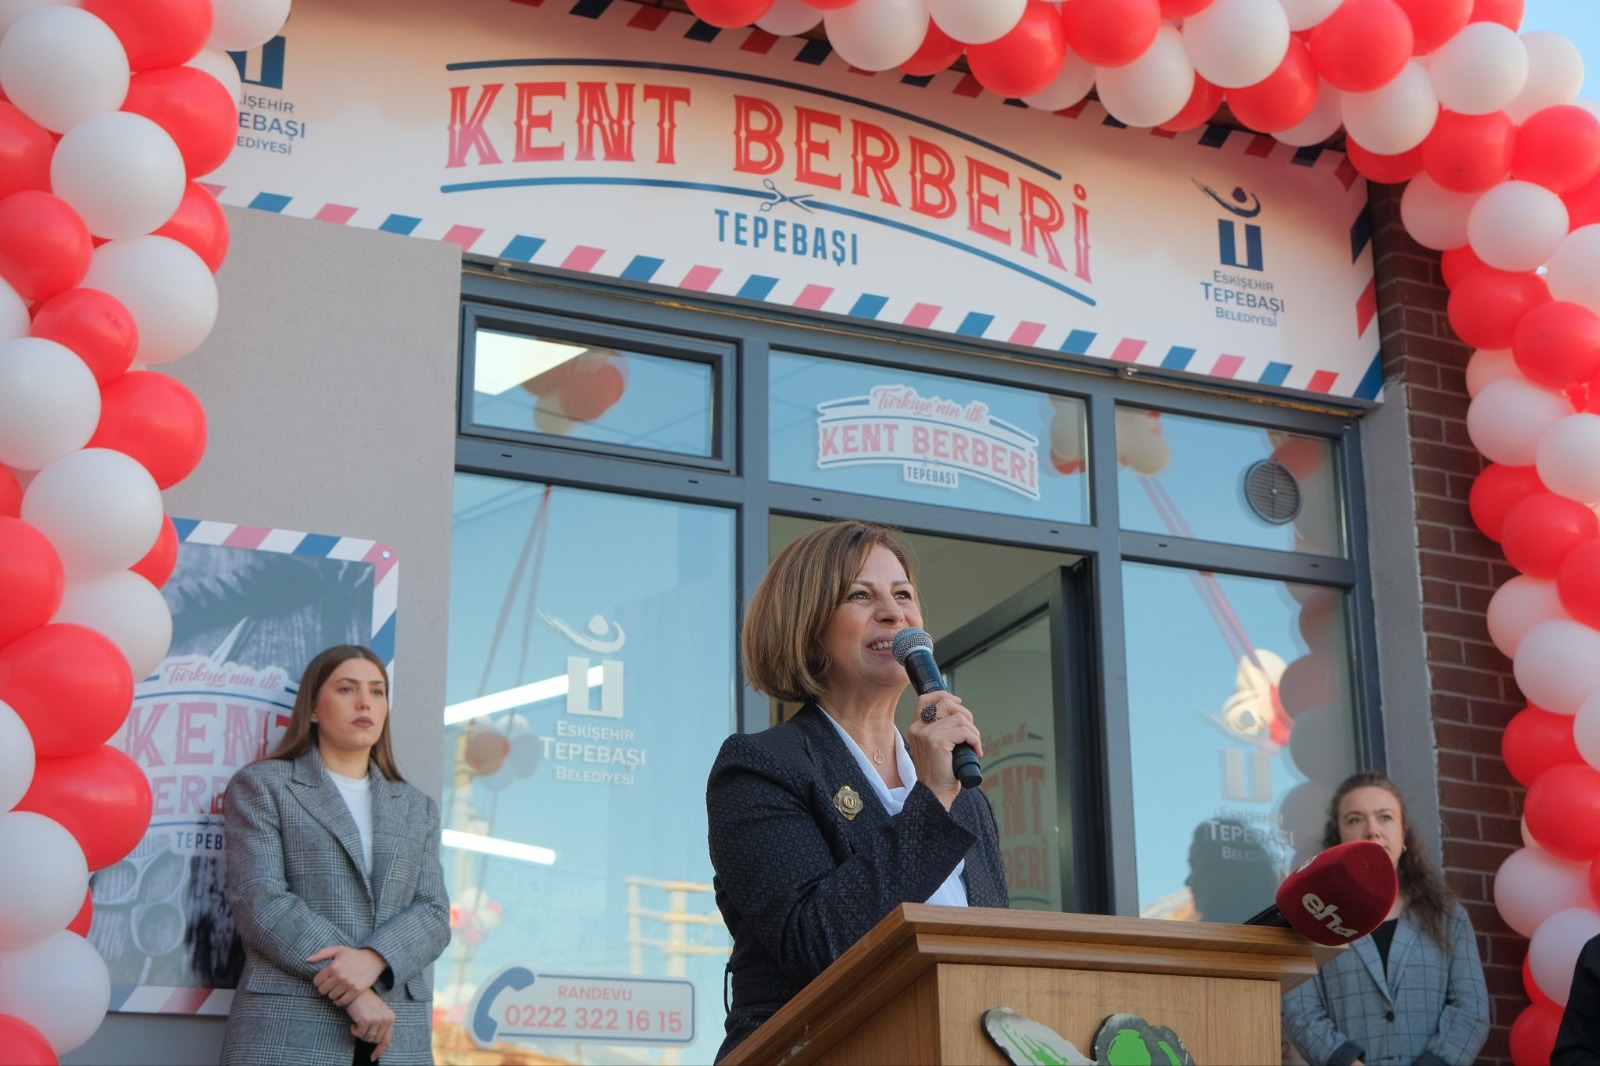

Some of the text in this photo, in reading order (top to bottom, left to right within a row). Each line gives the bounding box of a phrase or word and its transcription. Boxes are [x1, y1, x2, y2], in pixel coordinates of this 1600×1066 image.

[240, 92, 294, 114] İŞEHİR
[239, 111, 305, 141] EBAŞI
[237, 136, 292, 155] EDİYESİ
[444, 81, 1092, 284] KENT BERBERİ
[714, 209, 858, 266] TEPEBAŞI
[1200, 281, 1285, 315] TEPEBAŞI
[821, 423, 1036, 488] KENT BERBERİ
[907, 466, 955, 484] TEPEBAŞI
[125, 702, 291, 768] KEN
[539, 736, 646, 770] TEPEBAŞI
[176, 831, 223, 850] TEPEB
[558, 986, 632, 1002] RANDEVU
[505, 1004, 682, 1033] 0222 322 16 15
